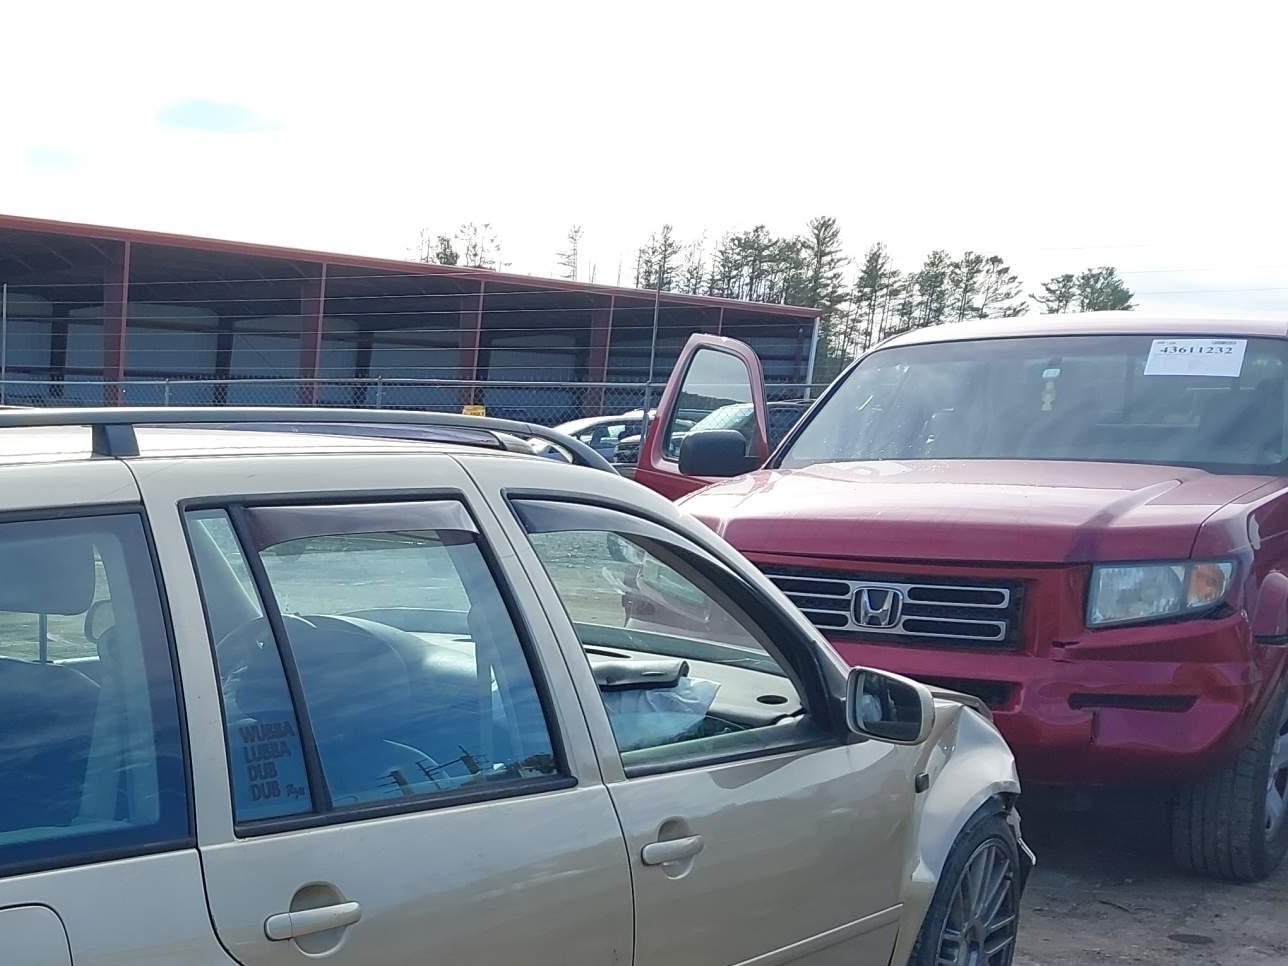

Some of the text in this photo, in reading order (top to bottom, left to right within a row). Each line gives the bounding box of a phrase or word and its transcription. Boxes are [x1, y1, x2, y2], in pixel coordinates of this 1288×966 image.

[1159, 346, 1233, 354] 43611232
[248, 761, 278, 782] DUB
[250, 780, 281, 801] DUB
